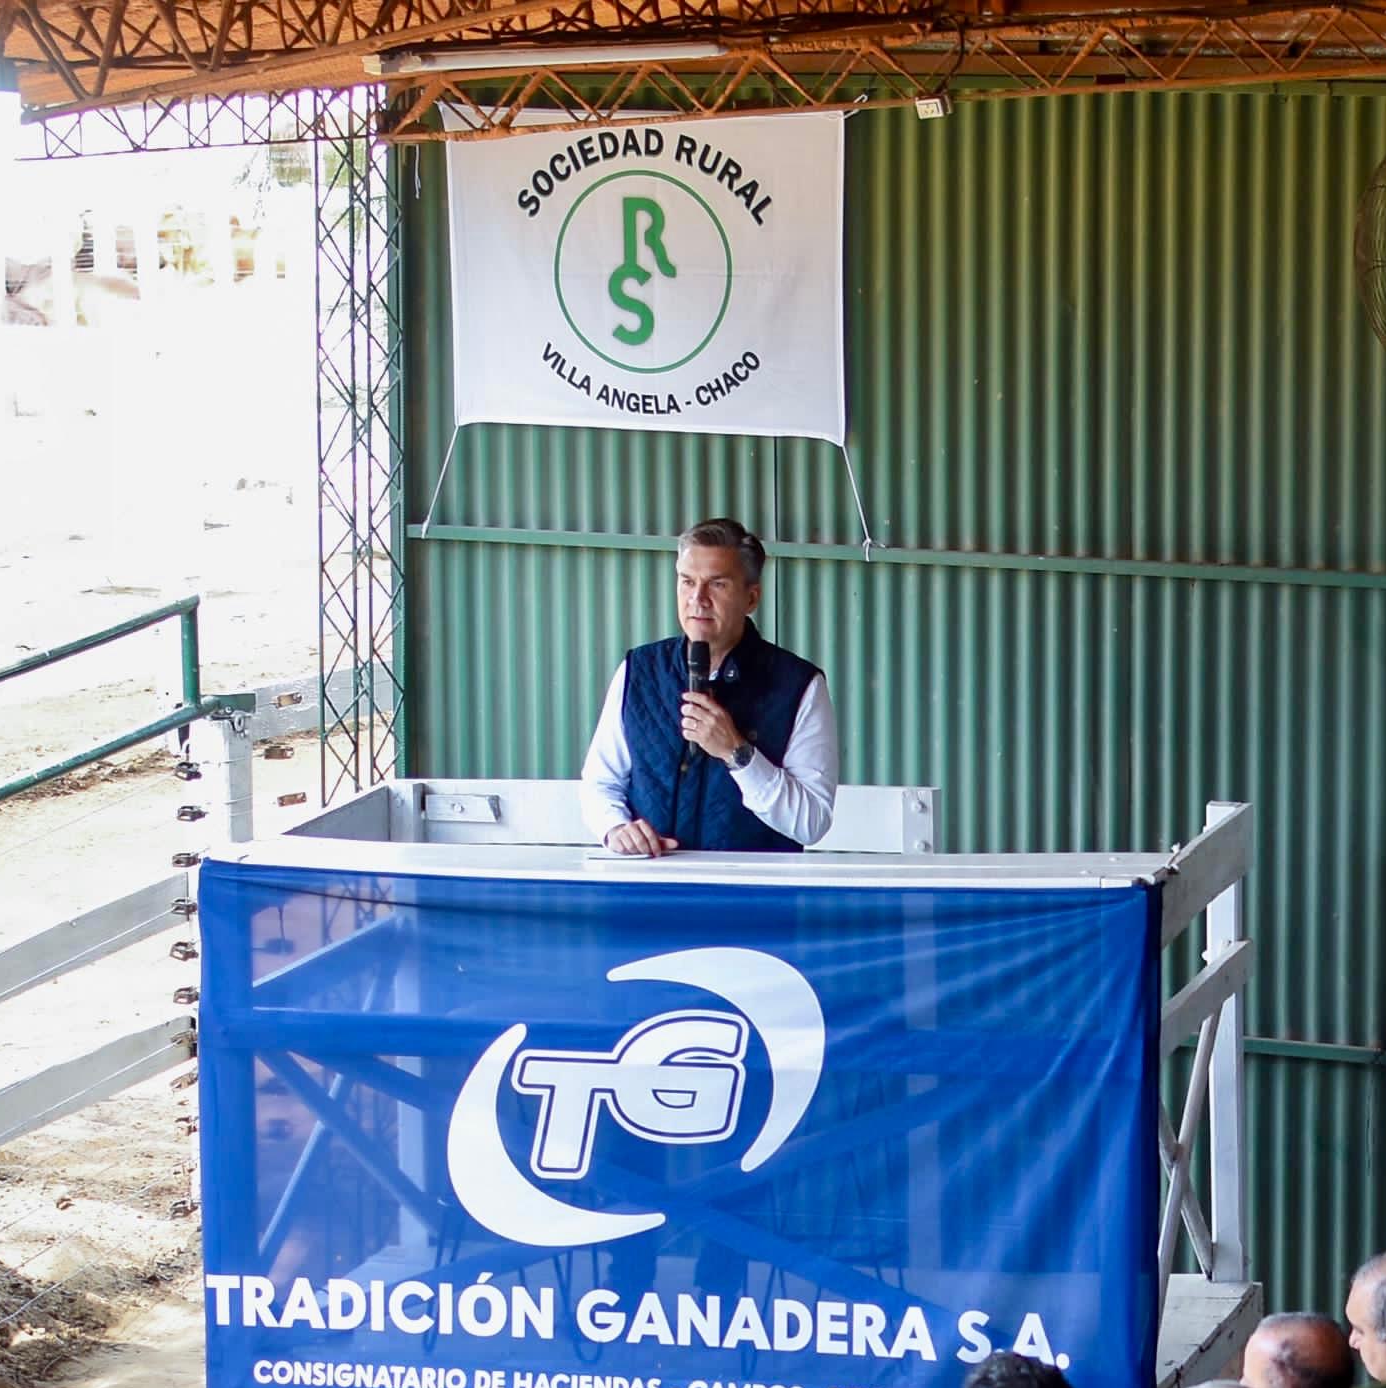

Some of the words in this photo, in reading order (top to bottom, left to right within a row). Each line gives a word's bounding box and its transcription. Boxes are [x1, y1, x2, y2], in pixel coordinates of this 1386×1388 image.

[517, 127, 665, 218] SOCIEDAD
[674, 134, 775, 227] RURAL
[541, 342, 591, 397] VILLA
[596, 383, 681, 415] ANGELA
[695, 350, 760, 407] CHACO
[513, 1008, 749, 1180] TG
[206, 1272, 554, 1339] TRADICIÓN
[576, 1289, 937, 1361] GANADERA
[957, 1310, 1070, 1370] S.A.
